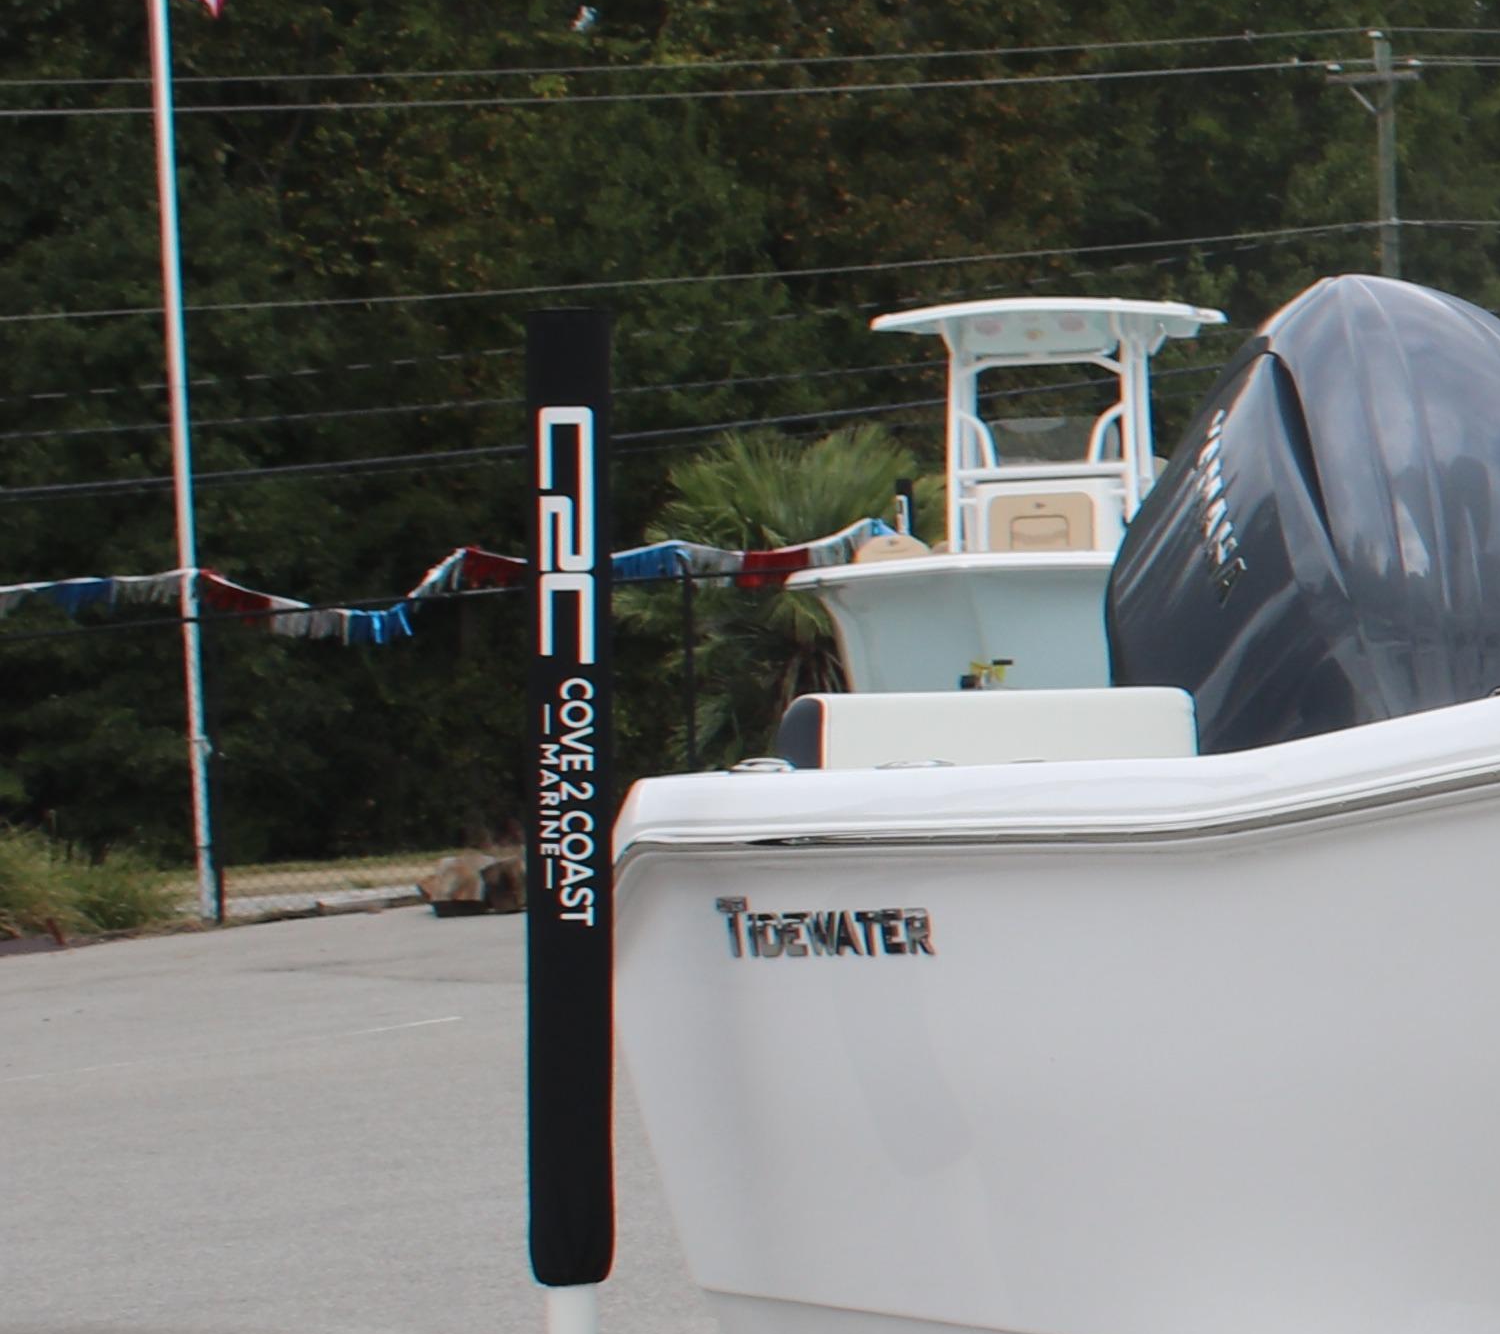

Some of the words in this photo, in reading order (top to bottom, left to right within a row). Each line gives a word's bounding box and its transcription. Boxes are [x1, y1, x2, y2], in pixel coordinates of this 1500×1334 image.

[538, 406, 595, 665] C2C
[559, 677, 595, 772] COVE
[539, 743, 561, 856] MARINE
[560, 781, 595, 802] 2
[559, 810, 595, 927] COAST
[716, 896, 936, 958] TIDEWATER
